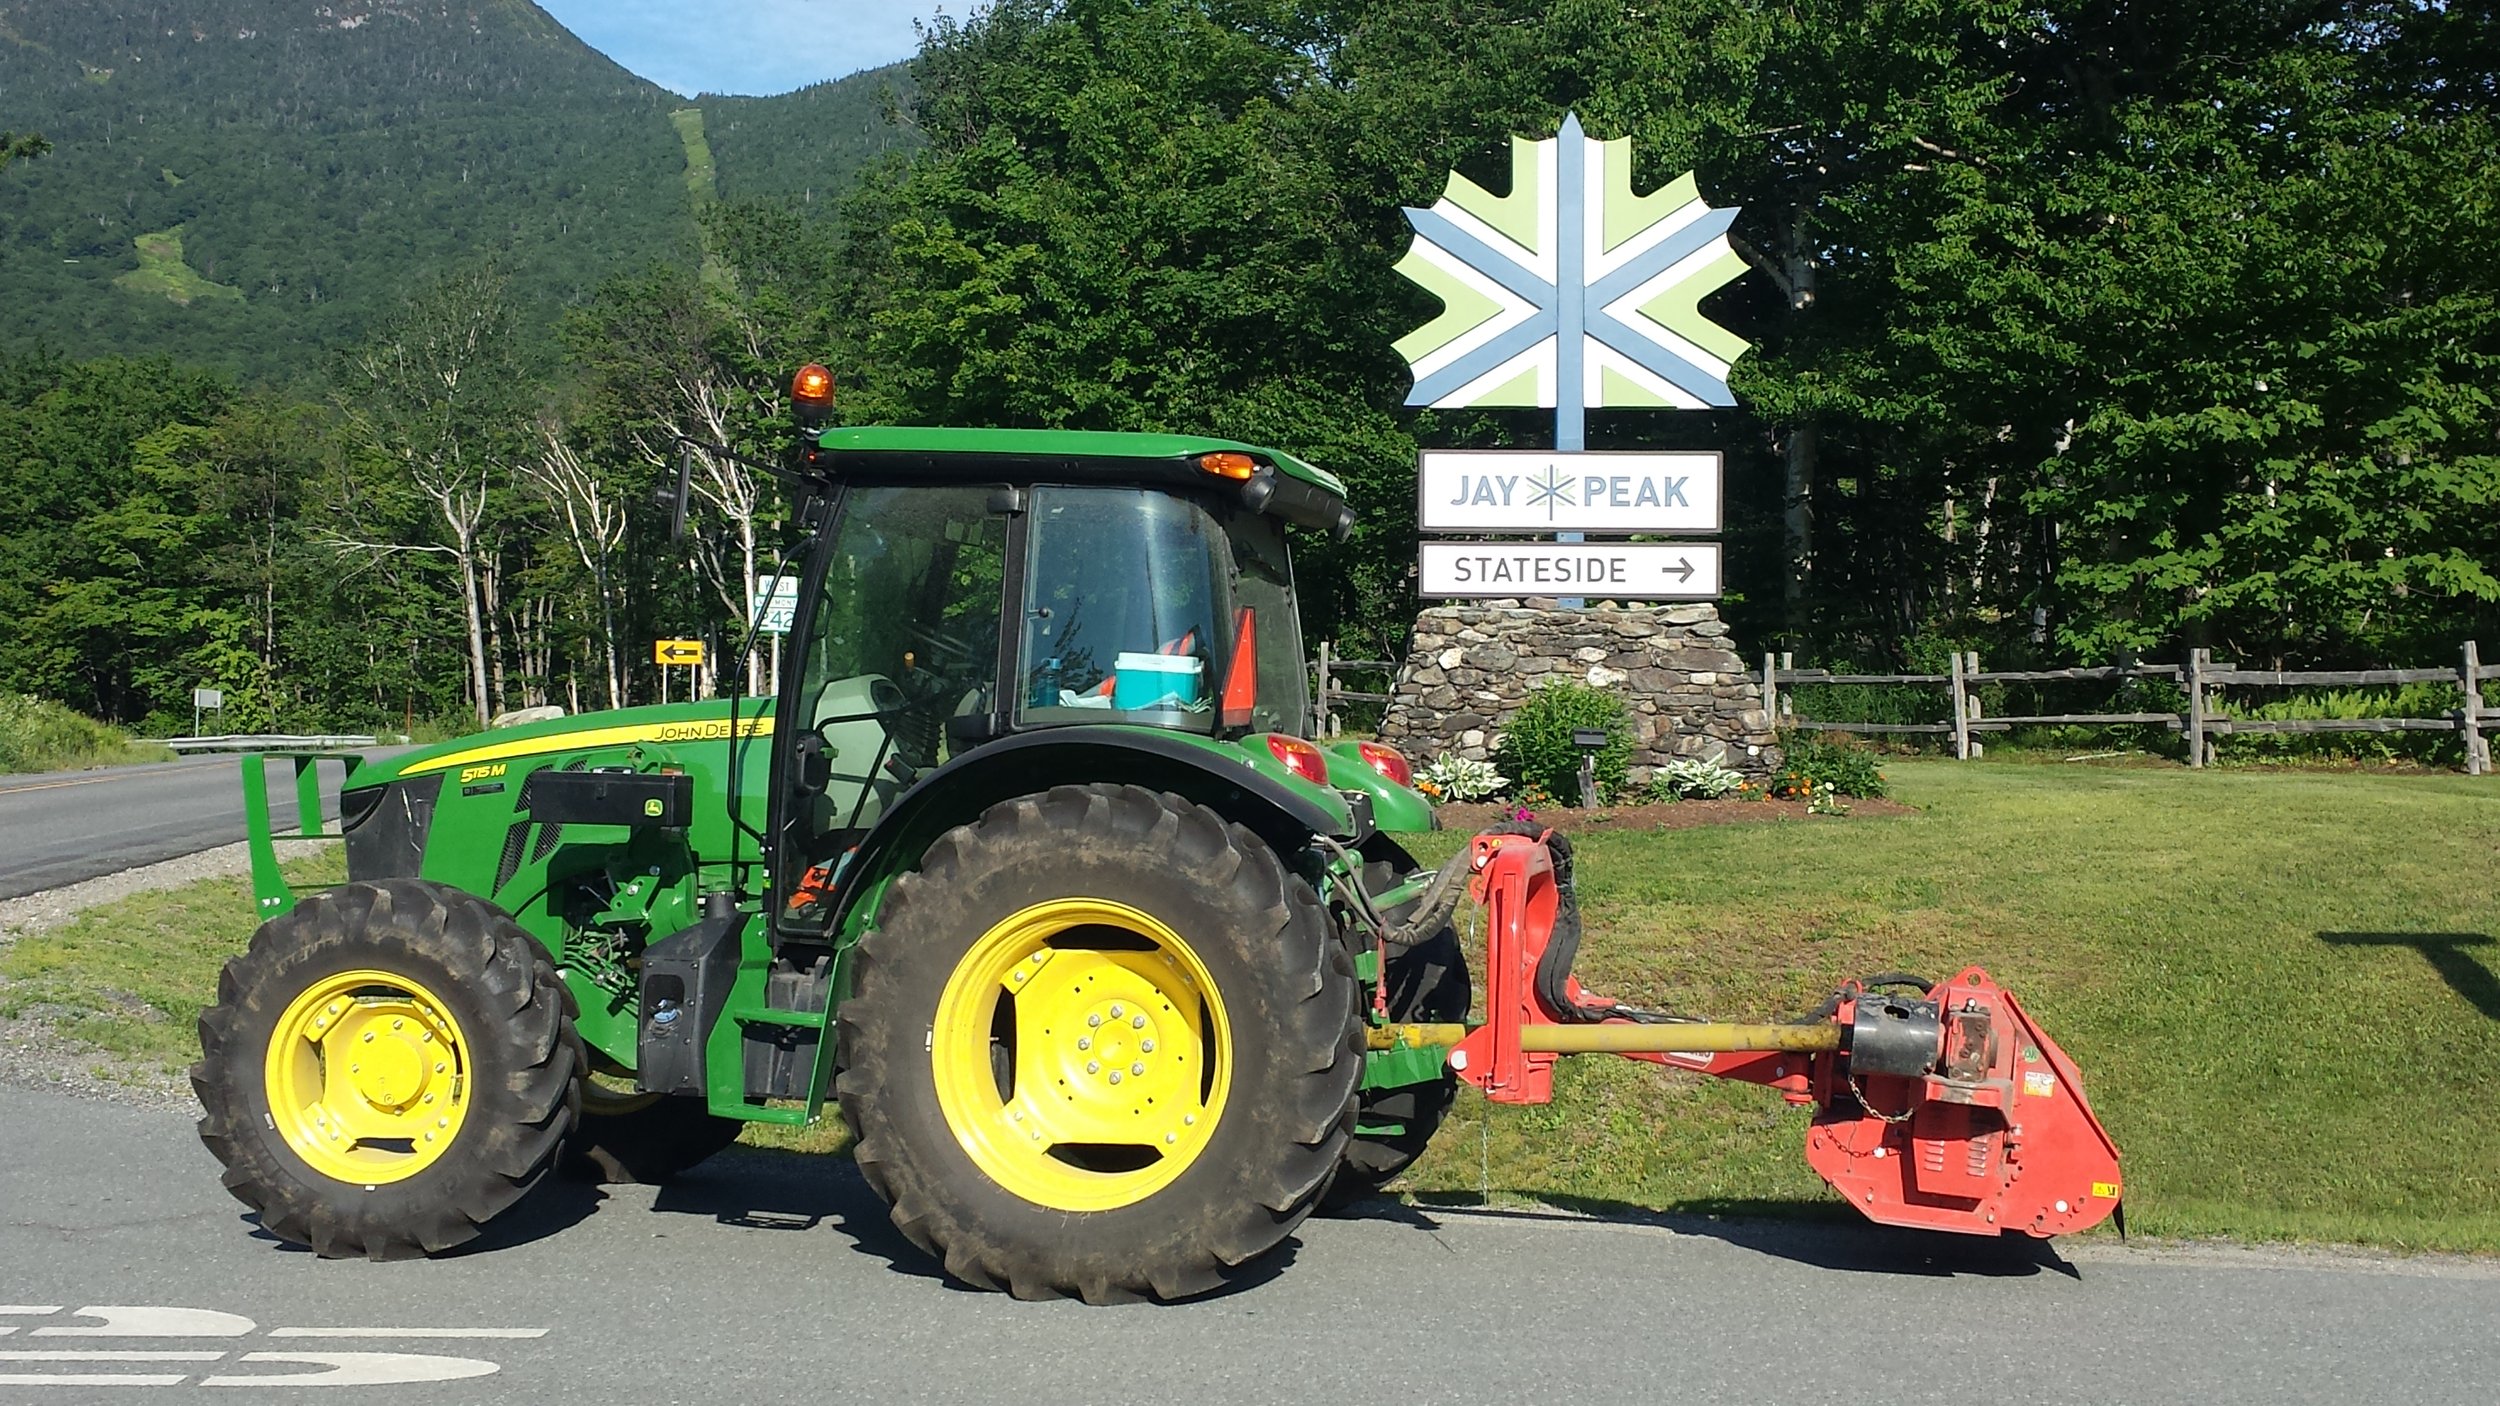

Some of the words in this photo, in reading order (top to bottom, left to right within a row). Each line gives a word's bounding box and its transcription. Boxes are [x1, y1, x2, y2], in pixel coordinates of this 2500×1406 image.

[1450, 475, 1519, 506] JAY
[1584, 476, 1689, 507] PEAK
[1454, 557, 1627, 583] STATESIDE
[764, 580, 790, 591] WST
[654, 726, 702, 739] JOHN
[705, 723, 764, 737] DERE
